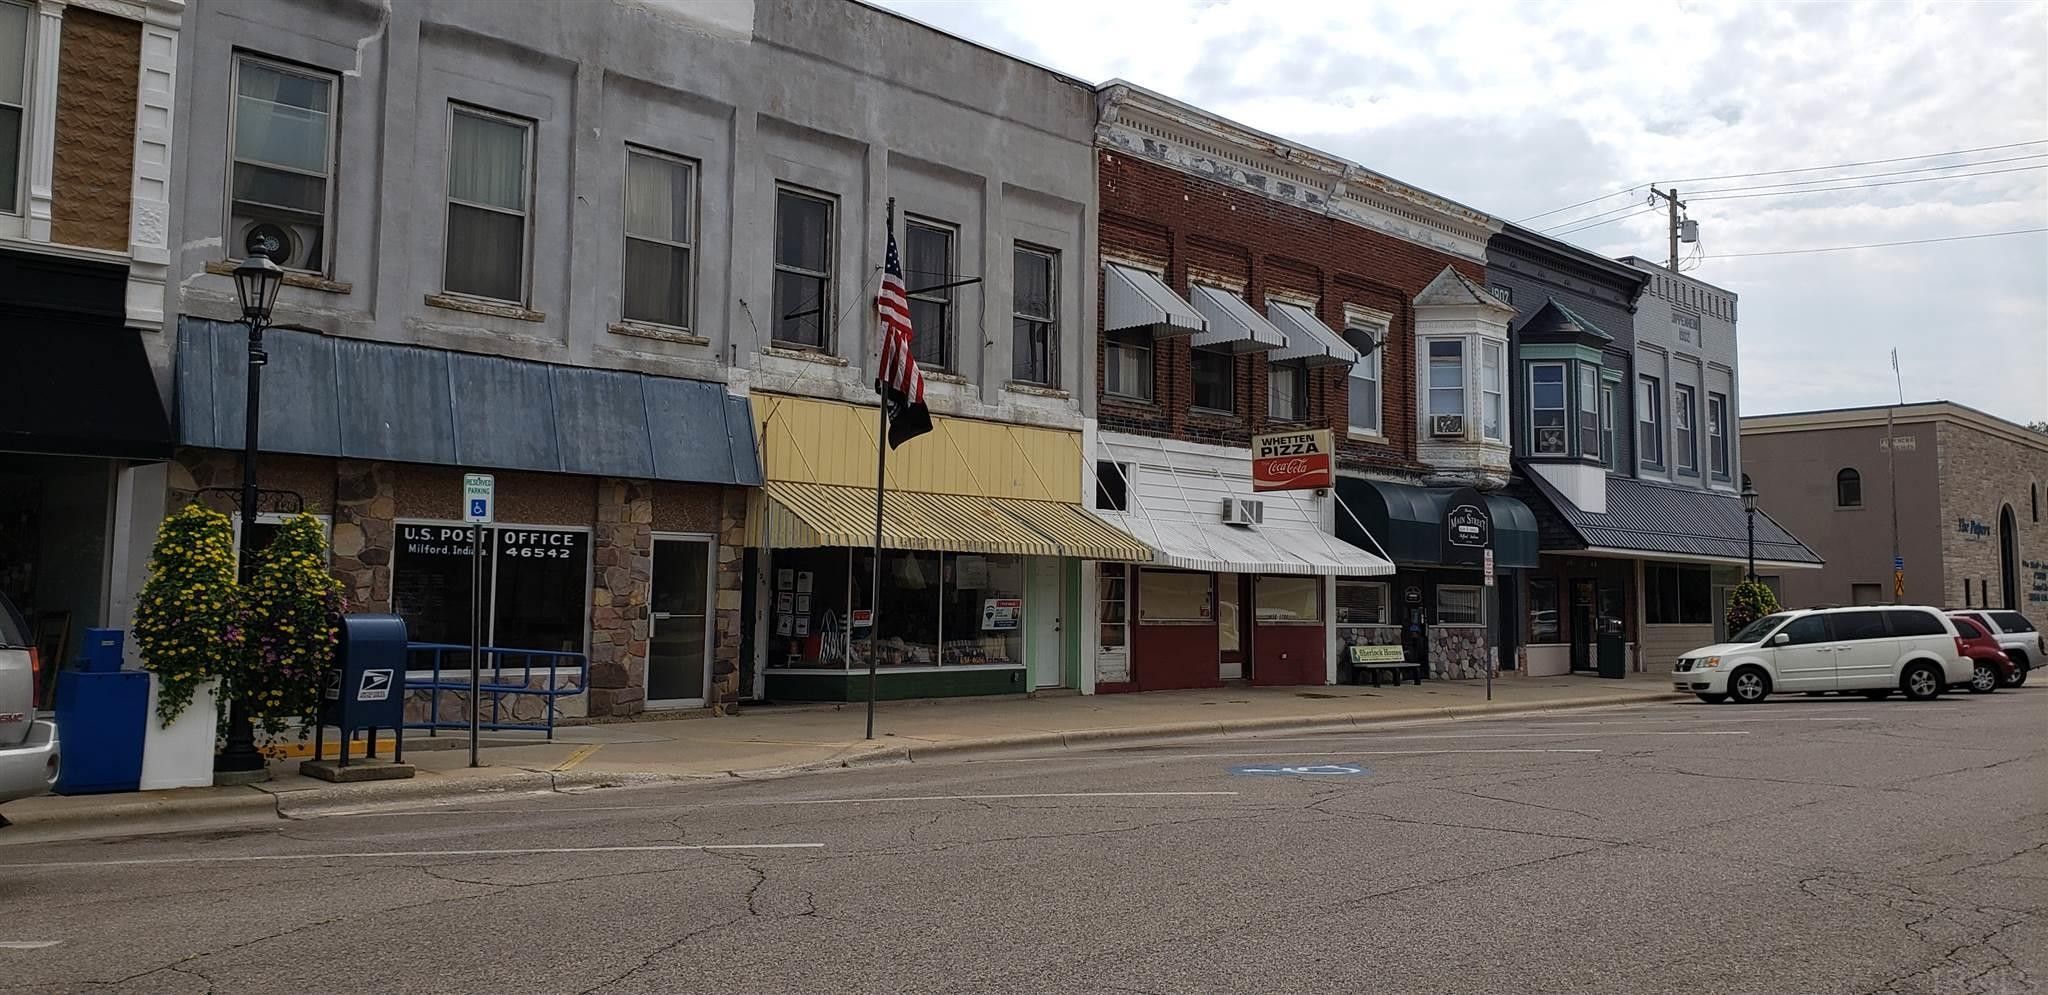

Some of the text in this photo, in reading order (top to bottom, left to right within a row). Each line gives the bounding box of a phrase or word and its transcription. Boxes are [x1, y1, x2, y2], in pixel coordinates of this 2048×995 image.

[1261, 434, 1315, 446] WHETTEN
[1261, 443, 1319, 458] PIZZA
[466, 478, 492, 487] RESERVED
[467, 487, 491, 495] PARKING
[404, 527, 575, 546] U.S. POST OFFICE
[505, 547, 571, 559] 46542
